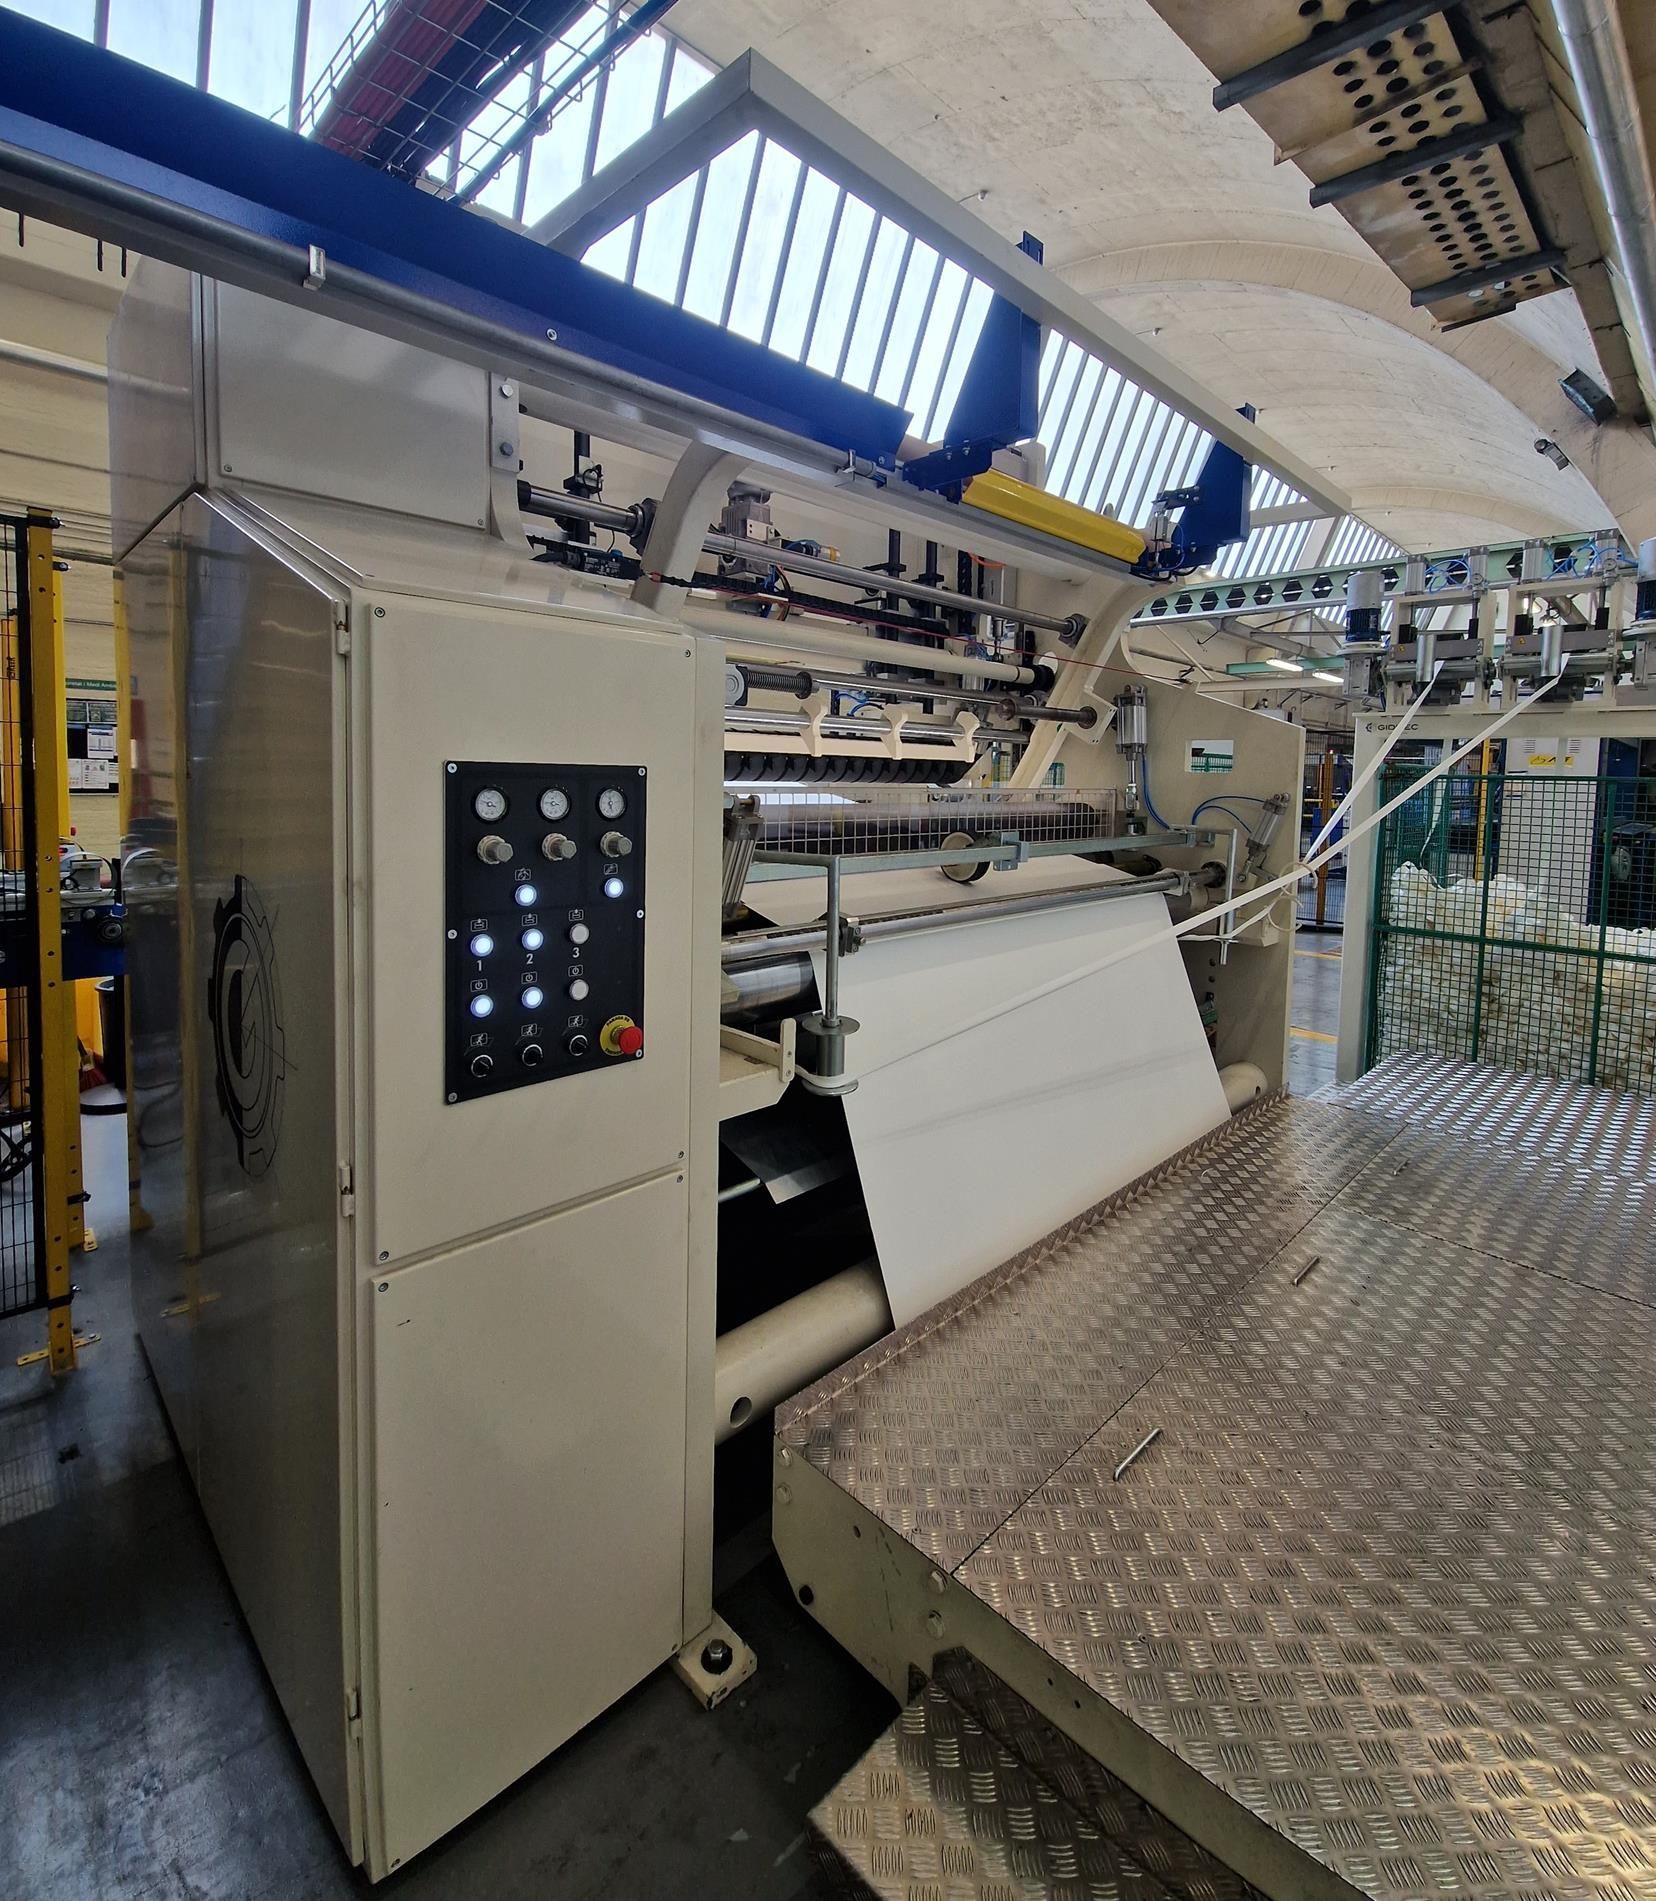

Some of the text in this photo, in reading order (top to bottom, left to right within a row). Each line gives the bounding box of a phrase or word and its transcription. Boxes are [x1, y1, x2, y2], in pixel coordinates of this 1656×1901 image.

[572, 947, 580, 958] 3
[526, 953, 534, 964] 2
[476, 960, 482, 971] 1
